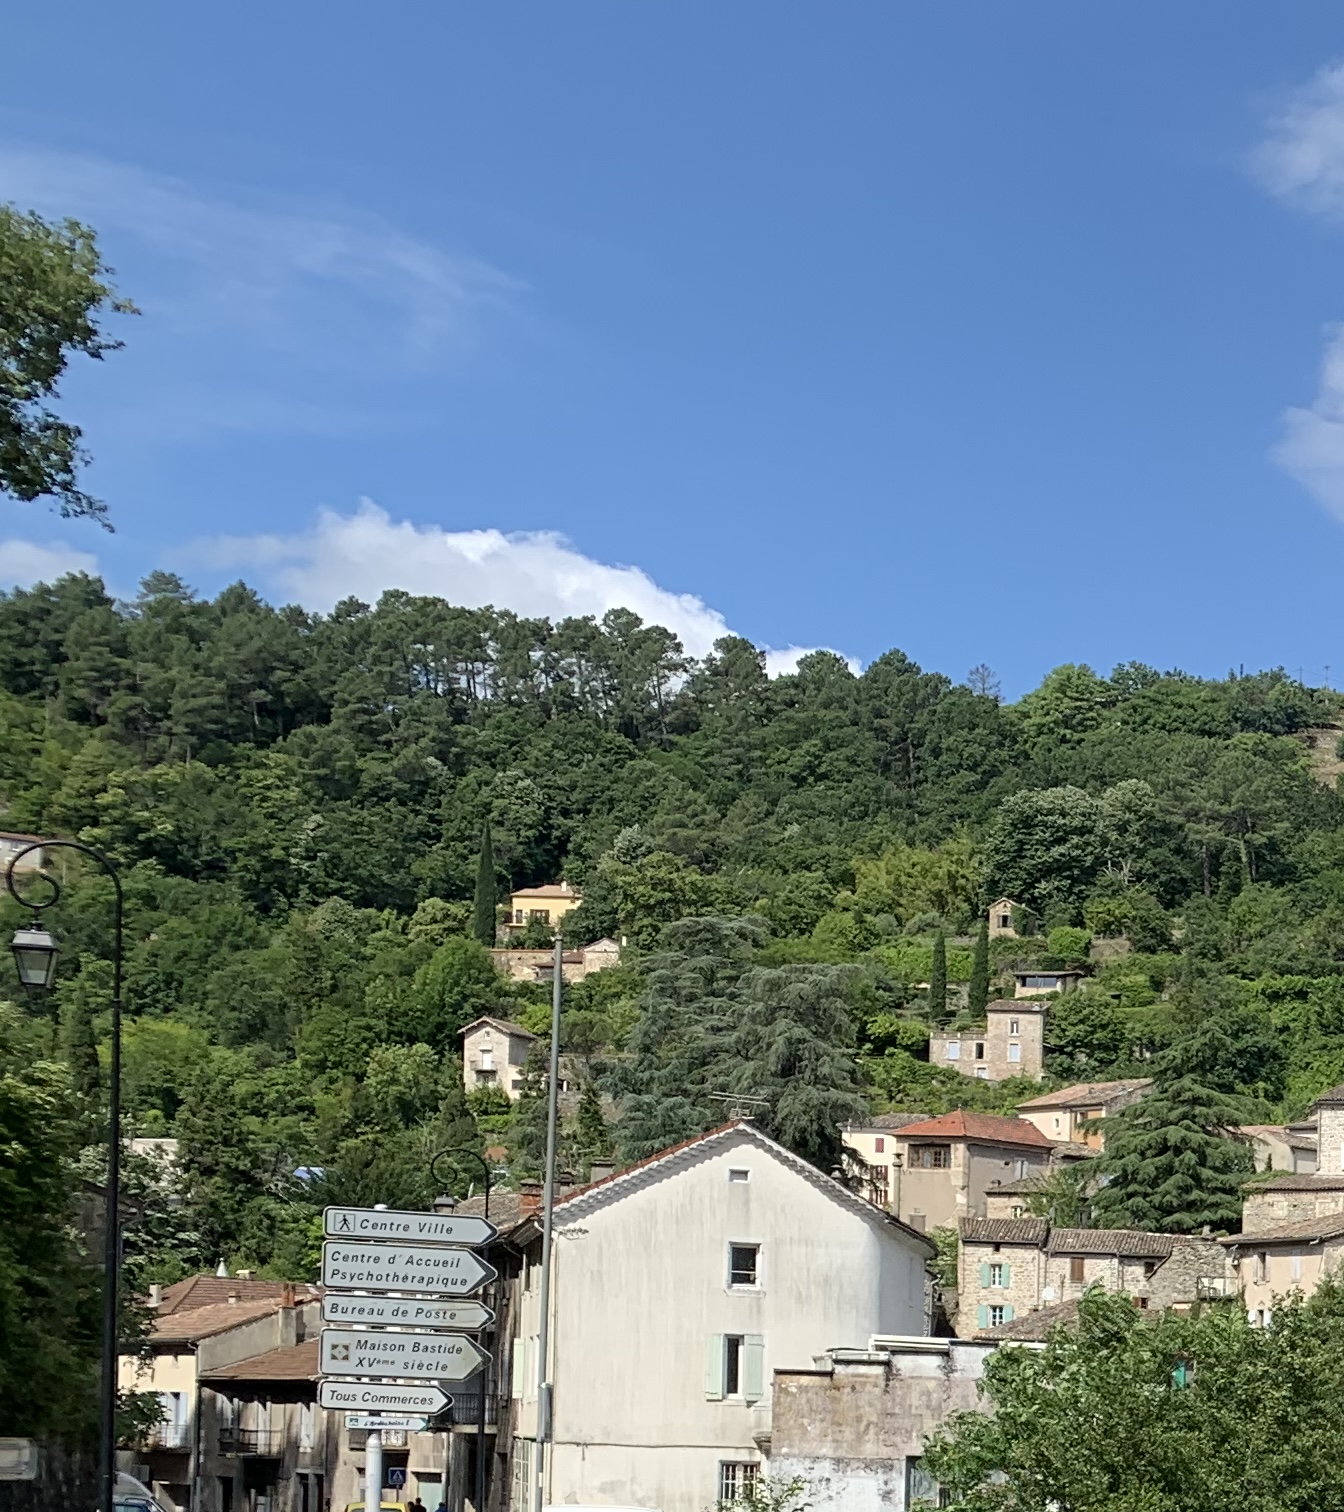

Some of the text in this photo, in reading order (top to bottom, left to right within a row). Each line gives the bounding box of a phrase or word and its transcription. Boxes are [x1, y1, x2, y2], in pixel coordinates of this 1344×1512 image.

[359, 1218, 454, 1235] Centre Ville
[330, 1250, 381, 1264] Centre
[330, 1268, 468, 1288] Psychothérapique
[329, 1302, 457, 1320] Bureau de Poste
[355, 1339, 463, 1355] Maison Bastide
[402, 1360, 449, 1372] siècle
[329, 1389, 434, 1406] Tous Commerces
